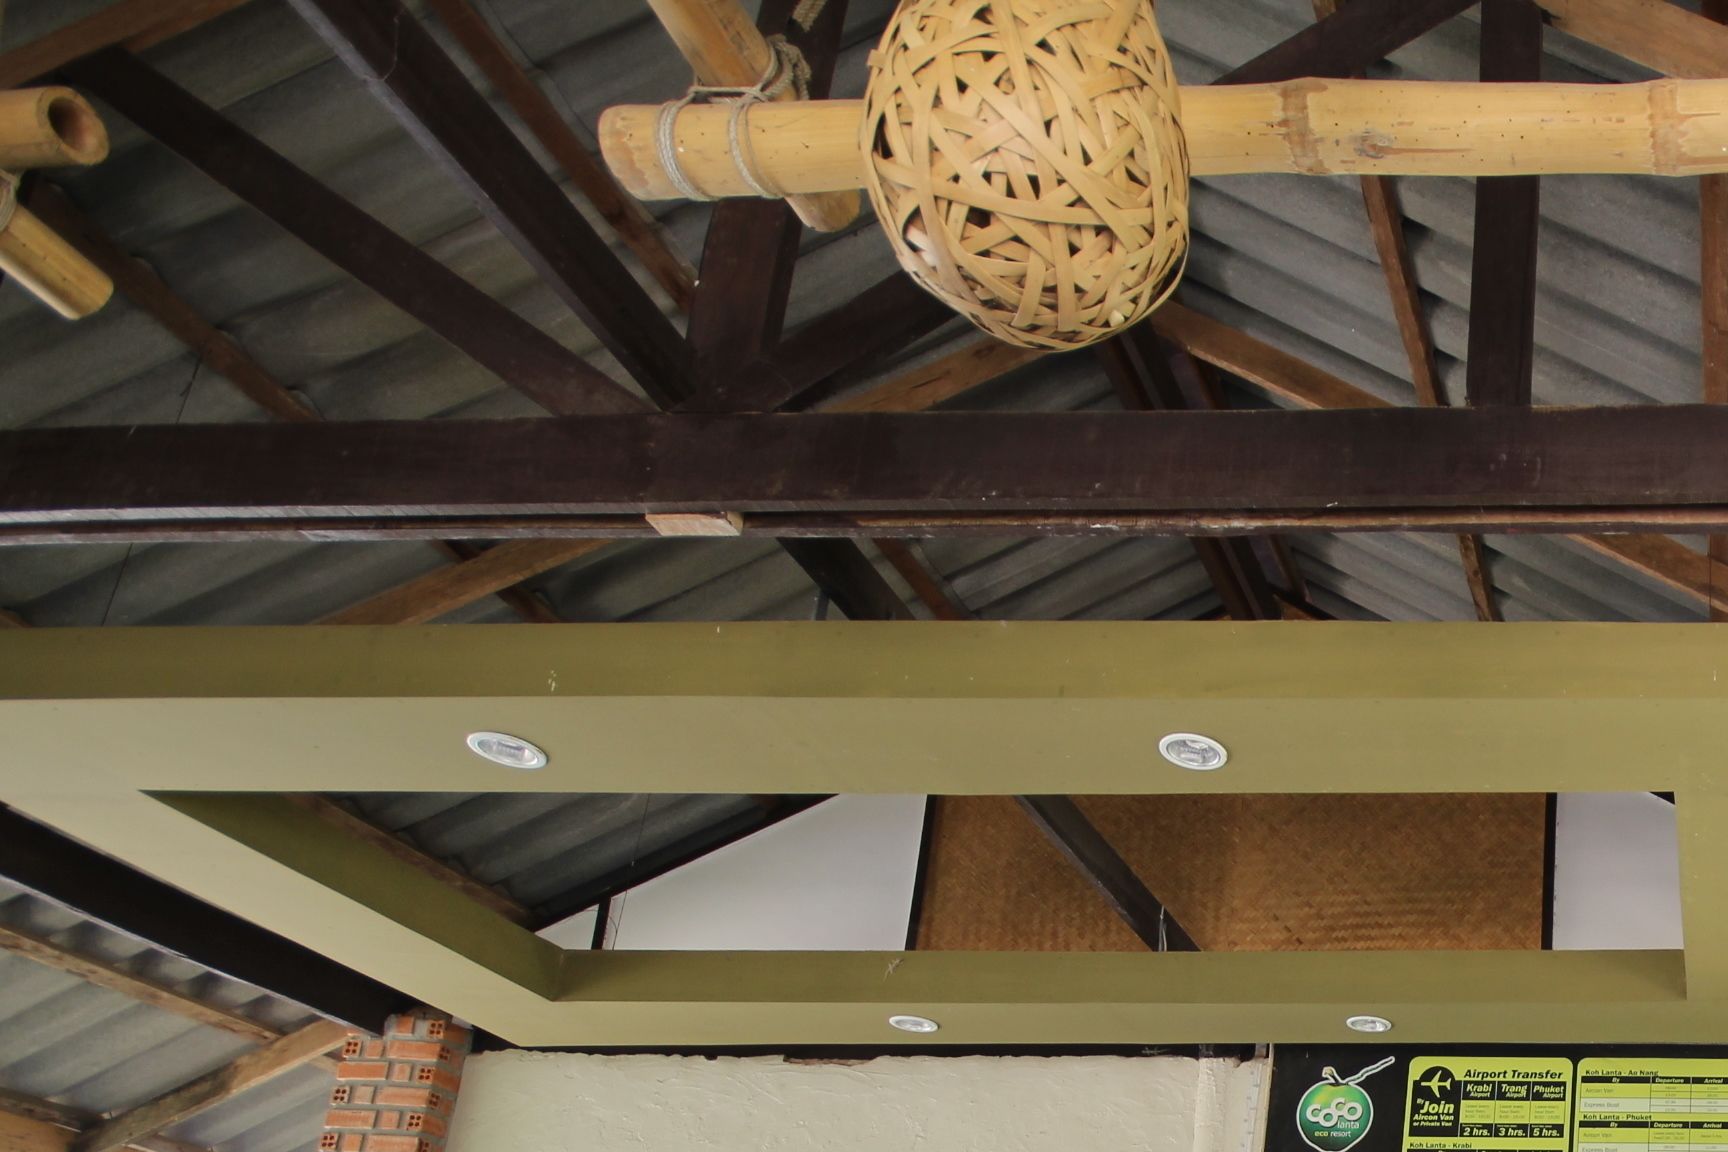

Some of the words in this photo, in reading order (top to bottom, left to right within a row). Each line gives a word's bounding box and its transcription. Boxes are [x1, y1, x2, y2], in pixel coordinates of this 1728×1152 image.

[1464, 1069, 1507, 1080] Airport
[1511, 1070, 1563, 1079] Transfer
[1467, 1083, 1492, 1092] Krabi
[1501, 1084, 1528, 1094] Trang
[1533, 1085, 1565, 1093] Phuket
[1421, 1101, 1454, 1114] Join
[1463, 1128, 1470, 1136] 2
[1473, 1128, 1490, 1136] hrs.
[1499, 1128, 1505, 1136] 3
[1508, 1128, 1526, 1136] hrs.
[1533, 1128, 1539, 1136] 5
[1542, 1128, 1560, 1136] hrs.
